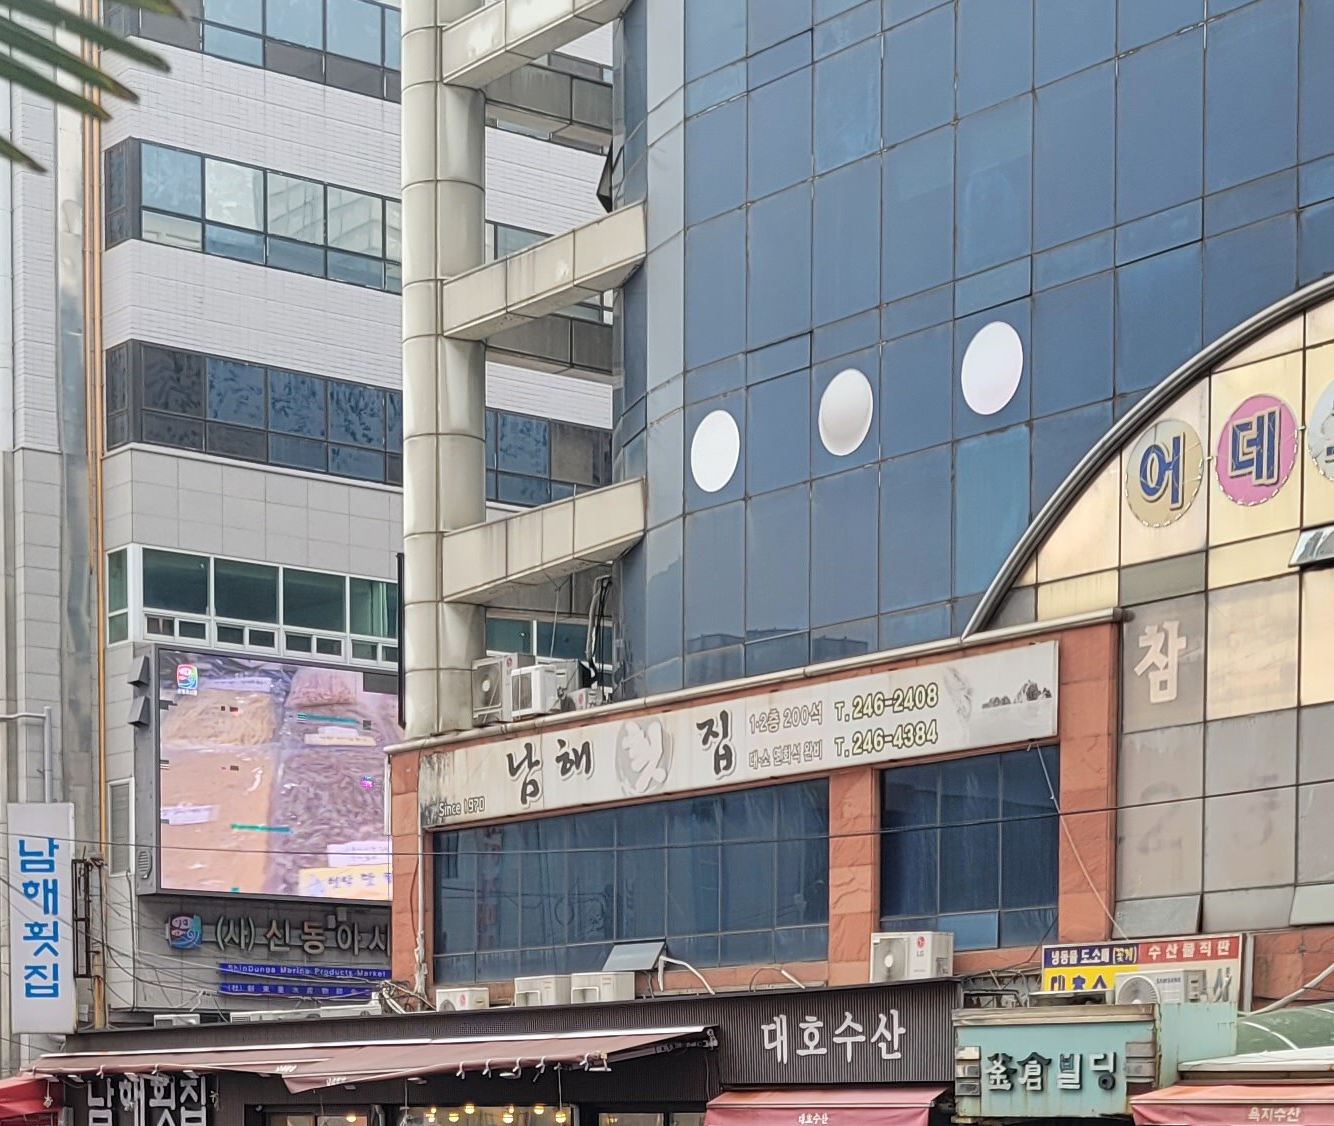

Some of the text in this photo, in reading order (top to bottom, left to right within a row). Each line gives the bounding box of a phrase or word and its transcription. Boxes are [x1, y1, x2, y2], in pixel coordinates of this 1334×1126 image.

[783, 700, 823, 729] 200석
[438, 796, 486, 818] Since 1970
[18, 838, 61, 999] 남해횟집
[1147, 940, 1231, 961] 수산물직판
[357, 968, 386, 978] Market
[760, 1008, 907, 1065] 대호수산
[798, 1112, 829, 1125] 대호수산
